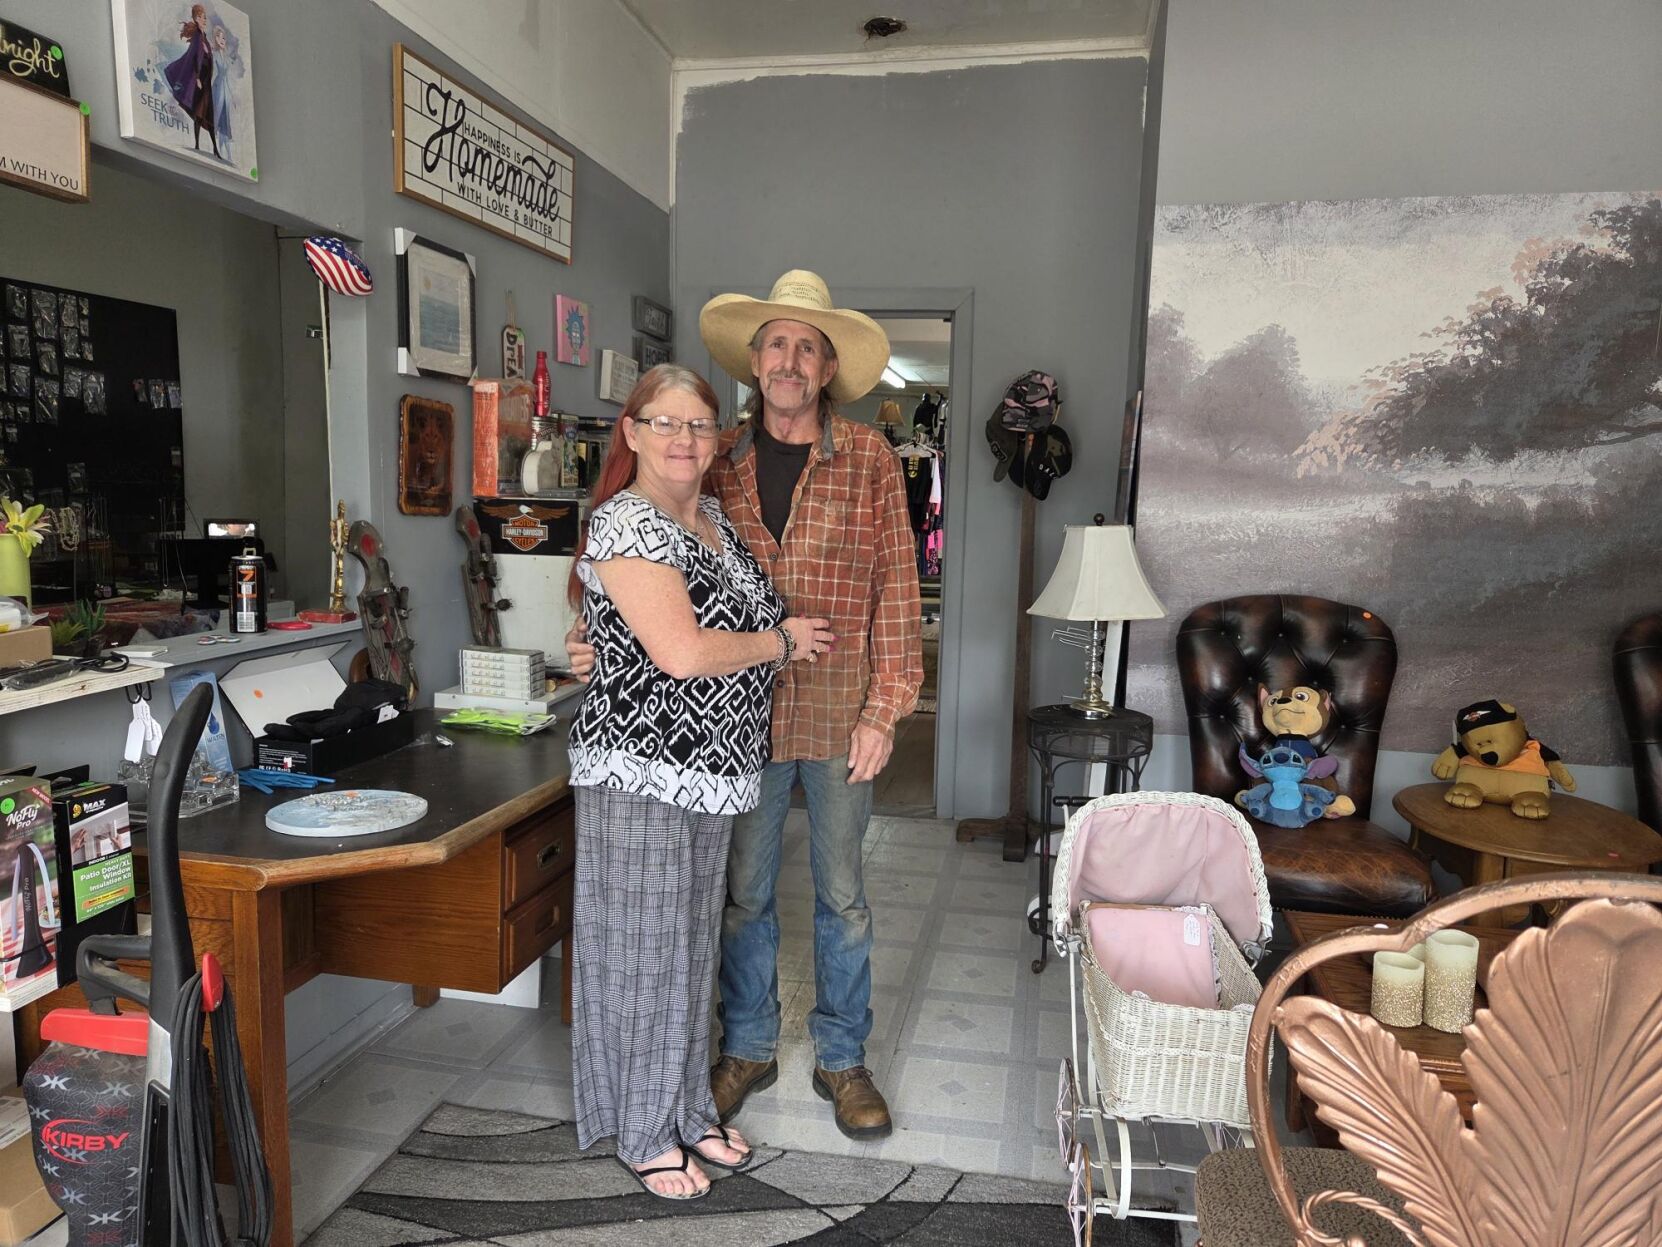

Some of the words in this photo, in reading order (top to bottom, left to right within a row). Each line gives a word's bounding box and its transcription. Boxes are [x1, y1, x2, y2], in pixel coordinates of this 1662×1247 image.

[140, 92, 168, 114] SEEK
[150, 108, 190, 135] TRUTH
[423, 82, 561, 222] Homemade
[464, 121, 511, 158] HAPPINESS
[513, 152, 521, 165] IS
[10, 159, 47, 181] WITH
[50, 171, 79, 190] YOU
[457, 181, 482, 204] WITH
[486, 195, 510, 217] LOVE
[514, 209, 520, 221] &
[523, 213, 553, 237] BUTTER
[6, 804, 39, 827] NoFly
[83, 799, 106, 811] MAX
[80, 870, 100, 881] Patio
[89, 877, 122, 892] Insulation
[122, 872, 132, 880] Kit
[103, 867, 131, 880] Window
[45, 1127, 129, 1151] KIRBY
